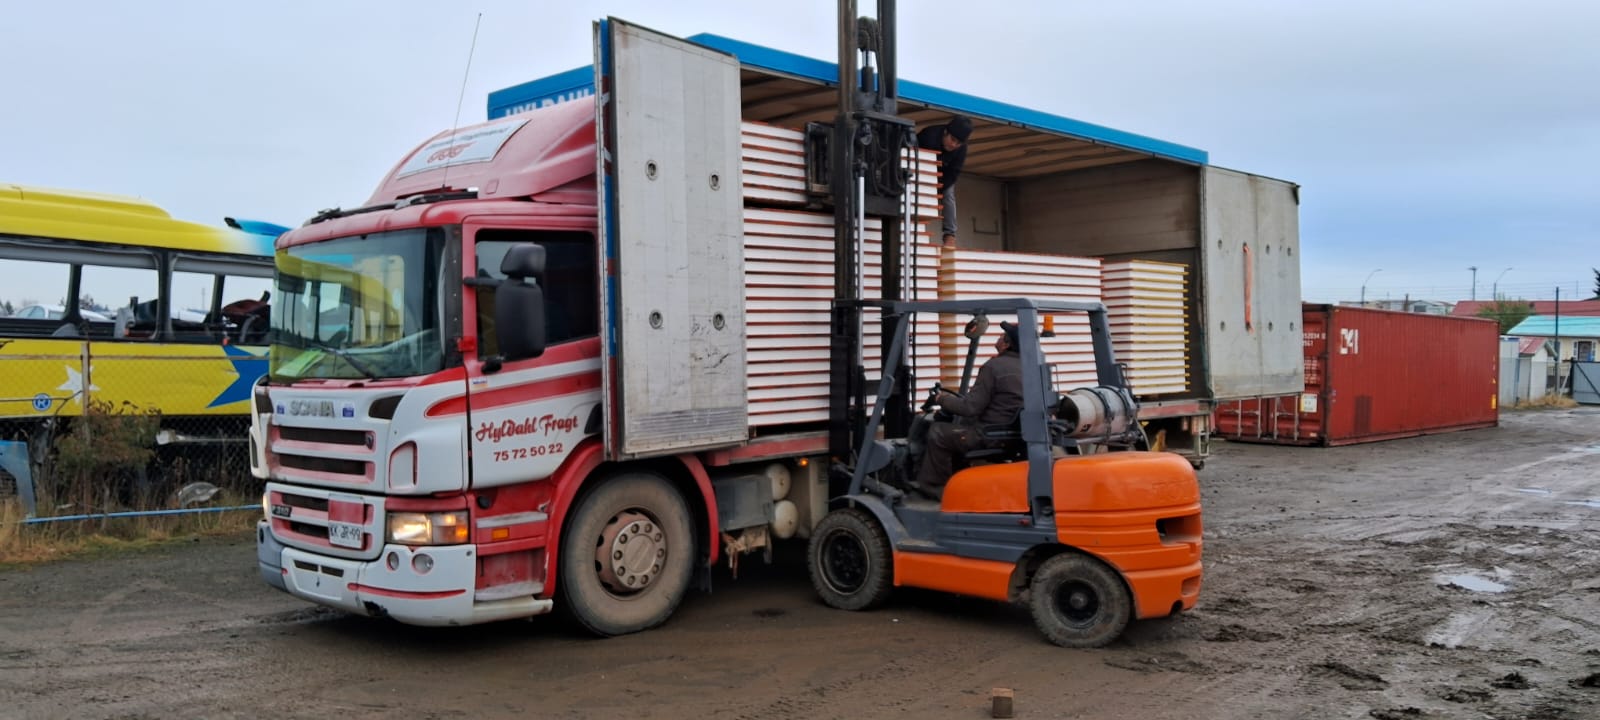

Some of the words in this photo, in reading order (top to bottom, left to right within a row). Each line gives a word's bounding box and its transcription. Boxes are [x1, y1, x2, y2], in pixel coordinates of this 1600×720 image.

[290, 400, 336, 418] SCANIA
[475, 417, 538, 443] Hyldahl
[539, 413, 579, 436] Fragt
[494, 450, 509, 462] 75
[512, 448, 527, 460] 72
[530, 446, 546, 457] 50
[549, 443, 563, 455] 22
